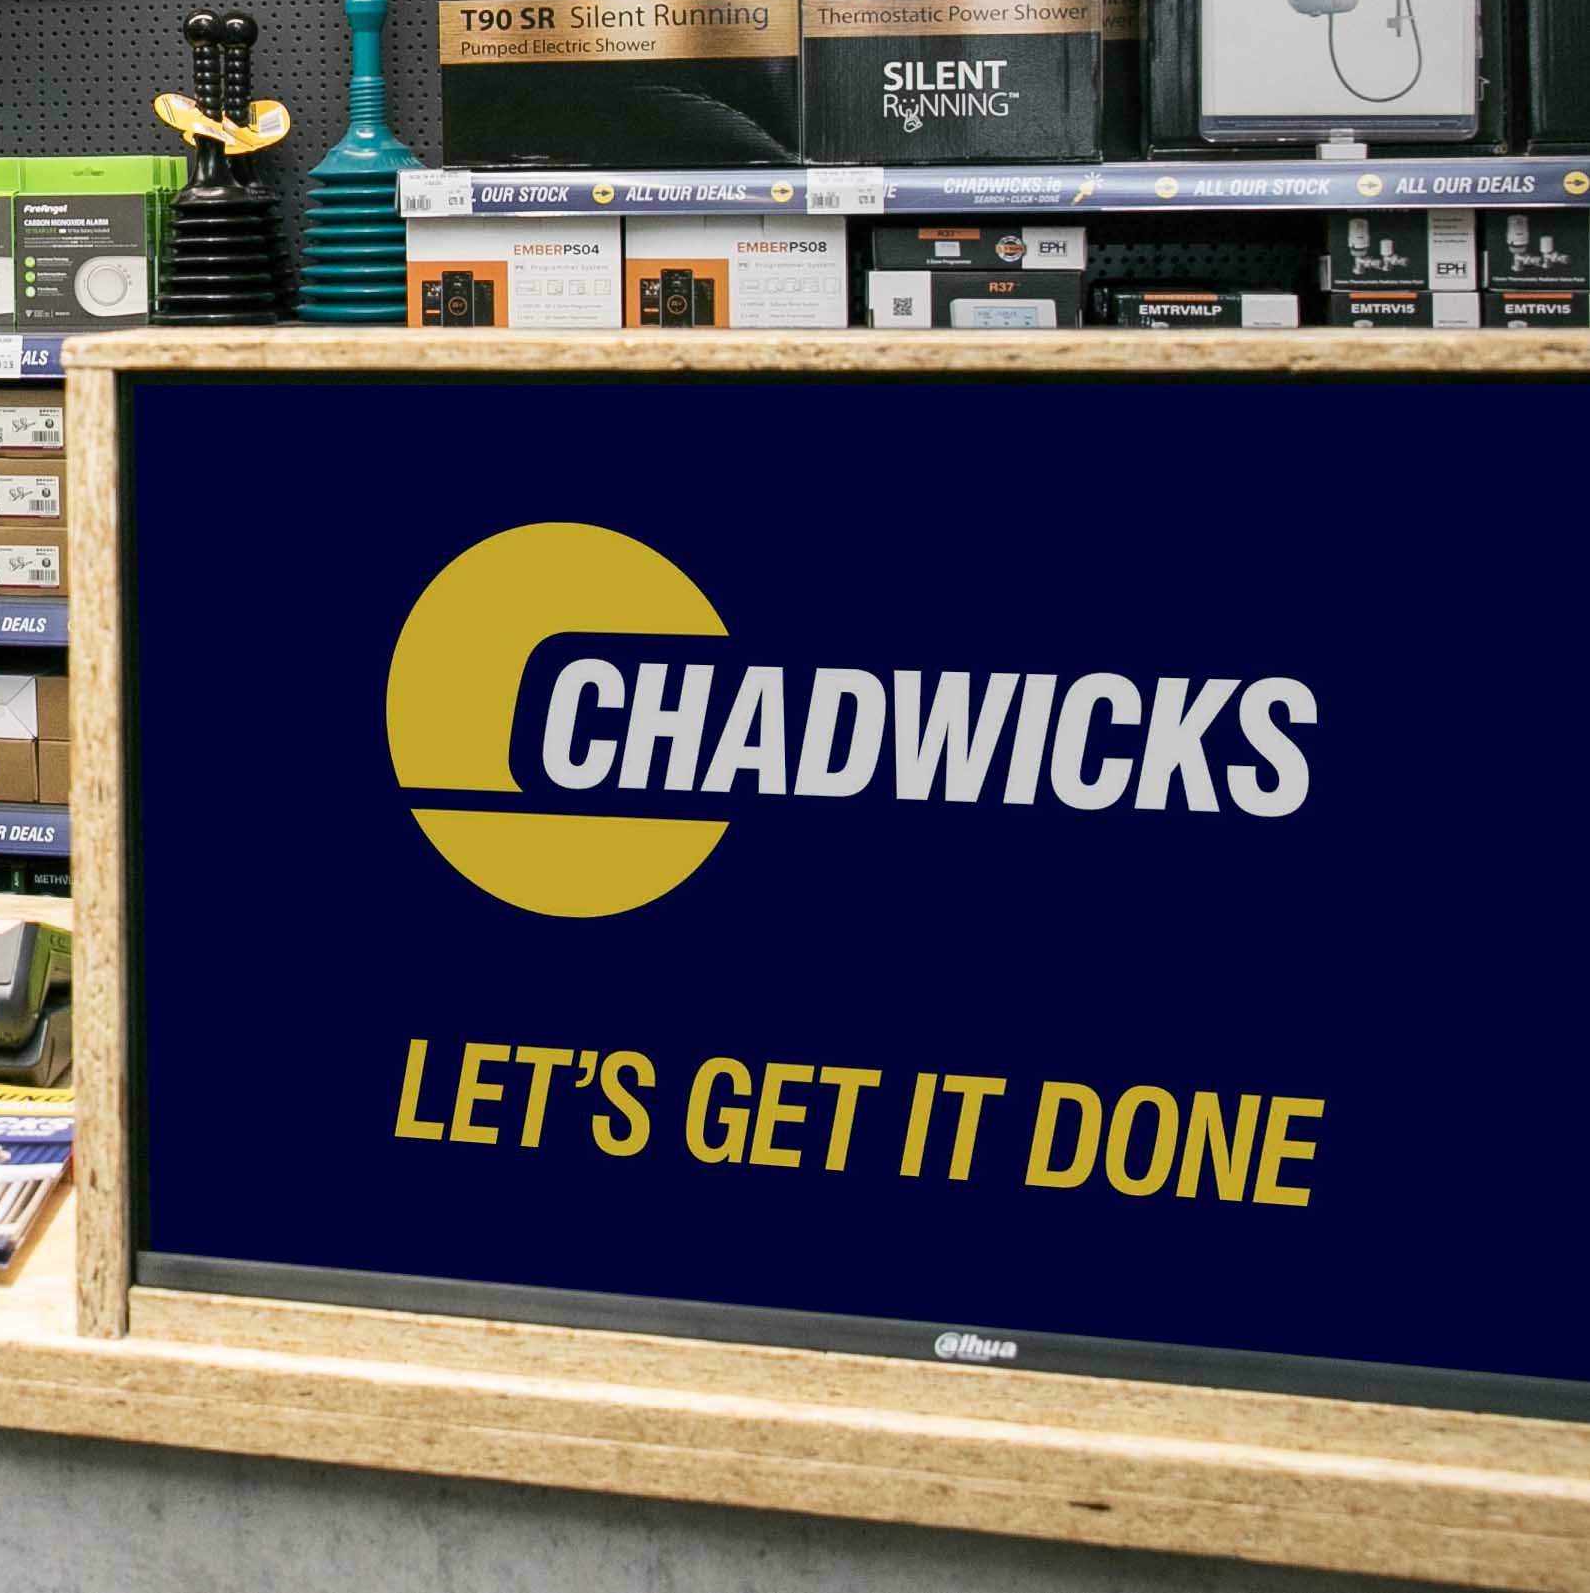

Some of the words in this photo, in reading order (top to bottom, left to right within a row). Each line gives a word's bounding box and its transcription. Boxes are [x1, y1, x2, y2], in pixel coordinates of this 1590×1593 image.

[460, 7, 513, 32] T90
[520, 6, 556, 30] SR
[570, 4, 646, 29] Silent
[654, 2, 770, 30] Running
[818, 5, 941, 26] Thermostatic
[948, 5, 1007, 23] Power
[1013, 2, 1088, 22] Shower
[460, 39, 528, 60] Pumped
[533, 36, 591, 56] Electric
[595, 36, 656, 55] Shower
[884, 60, 1007, 92] SILENT
[481, 184, 514, 203] OUR
[518, 184, 569, 203] STOCK
[626, 185, 655, 202] ALL
[658, 185, 692, 201] OUR
[695, 183, 746, 201] DEALS
[944, 177, 1063, 195] CHADWICKS.ie
[1194, 179, 1224, 196] ALL
[1228, 179, 1266, 196] OUR
[1271, 177, 1330, 196] STOCK
[1397, 178, 1428, 194] ALL
[1433, 178, 1471, 193] OUR
[1476, 176, 1535, 193] DEALS
[514, 244, 600, 256] EMBERPS04
[737, 241, 827, 254] EMBERPS08
[1039, 241, 1067, 256] EPH
[1436, 261, 1467, 277] EPH
[989, 282, 1014, 293] R37
[1139, 304, 1222, 317] EMTRVMLP
[1351, 303, 1415, 315] EMTRV15
[1505, 303, 1571, 315] EMTRV15
[0, 616, 47, 633] DEALS
[542, 657, 1319, 819] CHADWICKS
[393, 1038, 656, 1159] LET'S
[684, 1057, 882, 1173] GET
[900, 1072, 1007, 1181] IT
[1024, 1080, 1325, 1209] DONE
